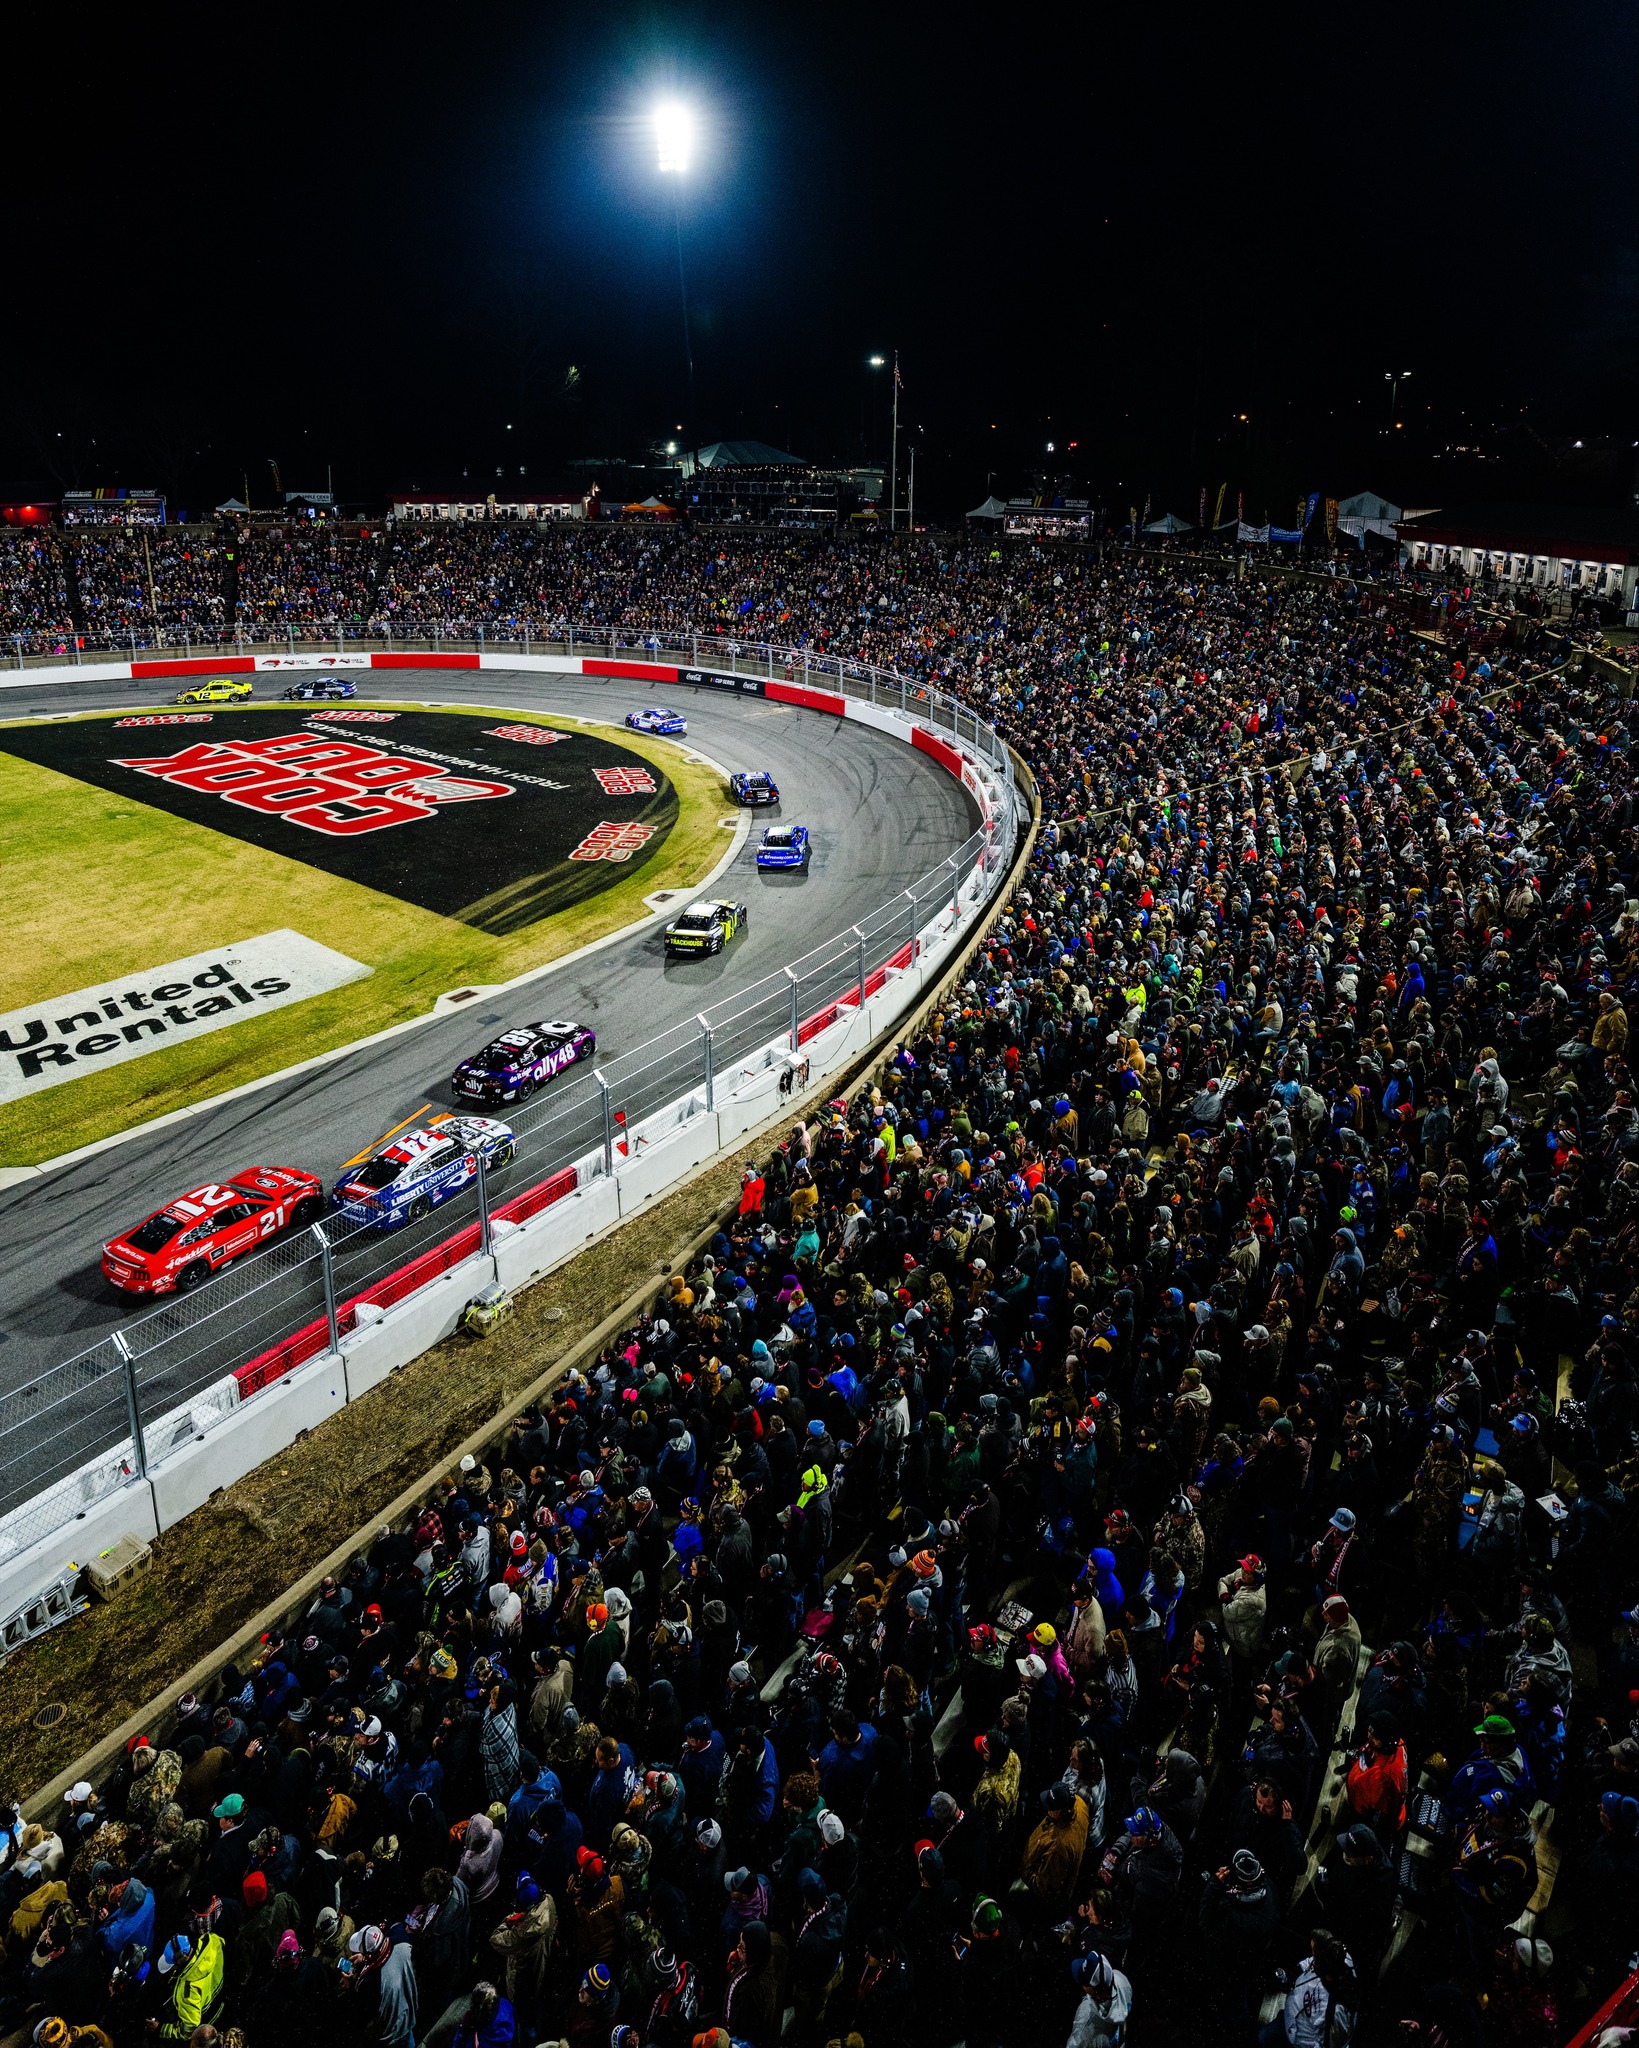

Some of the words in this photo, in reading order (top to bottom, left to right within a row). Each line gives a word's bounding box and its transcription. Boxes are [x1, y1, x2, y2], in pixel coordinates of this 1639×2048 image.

[301, 722, 360, 738] SHAKES
[219, 732, 449, 789] OUT
[391, 744, 510, 775] HAMBURGERS
[107, 742, 438, 836] COOK
[502, 772, 572, 790] FRESH
[591, 767, 635, 795] COOK
[568, 821, 631, 861] COOK
[611, 822, 659, 851] OUT
[670, 939, 703, 947] TRACKHOUSE
[0, 964, 236, 1050] United
[16, 977, 291, 1078] Rentals
[500, 1029, 537, 1046] 48
[468, 1070, 489, 1078] ally
[533, 1055, 559, 1081] ally
[558, 1043, 576, 1064] 48
[459, 1090, 486, 1099] CHEVROLET
[465, 1080, 483, 1093] ally
[394, 1132, 439, 1157] 24
[391, 1184, 425, 1207] LIBERTY
[425, 1160, 464, 1189] UNIVERSITY
[173, 1185, 236, 1217] 21
[259, 1205, 285, 1236] 21
